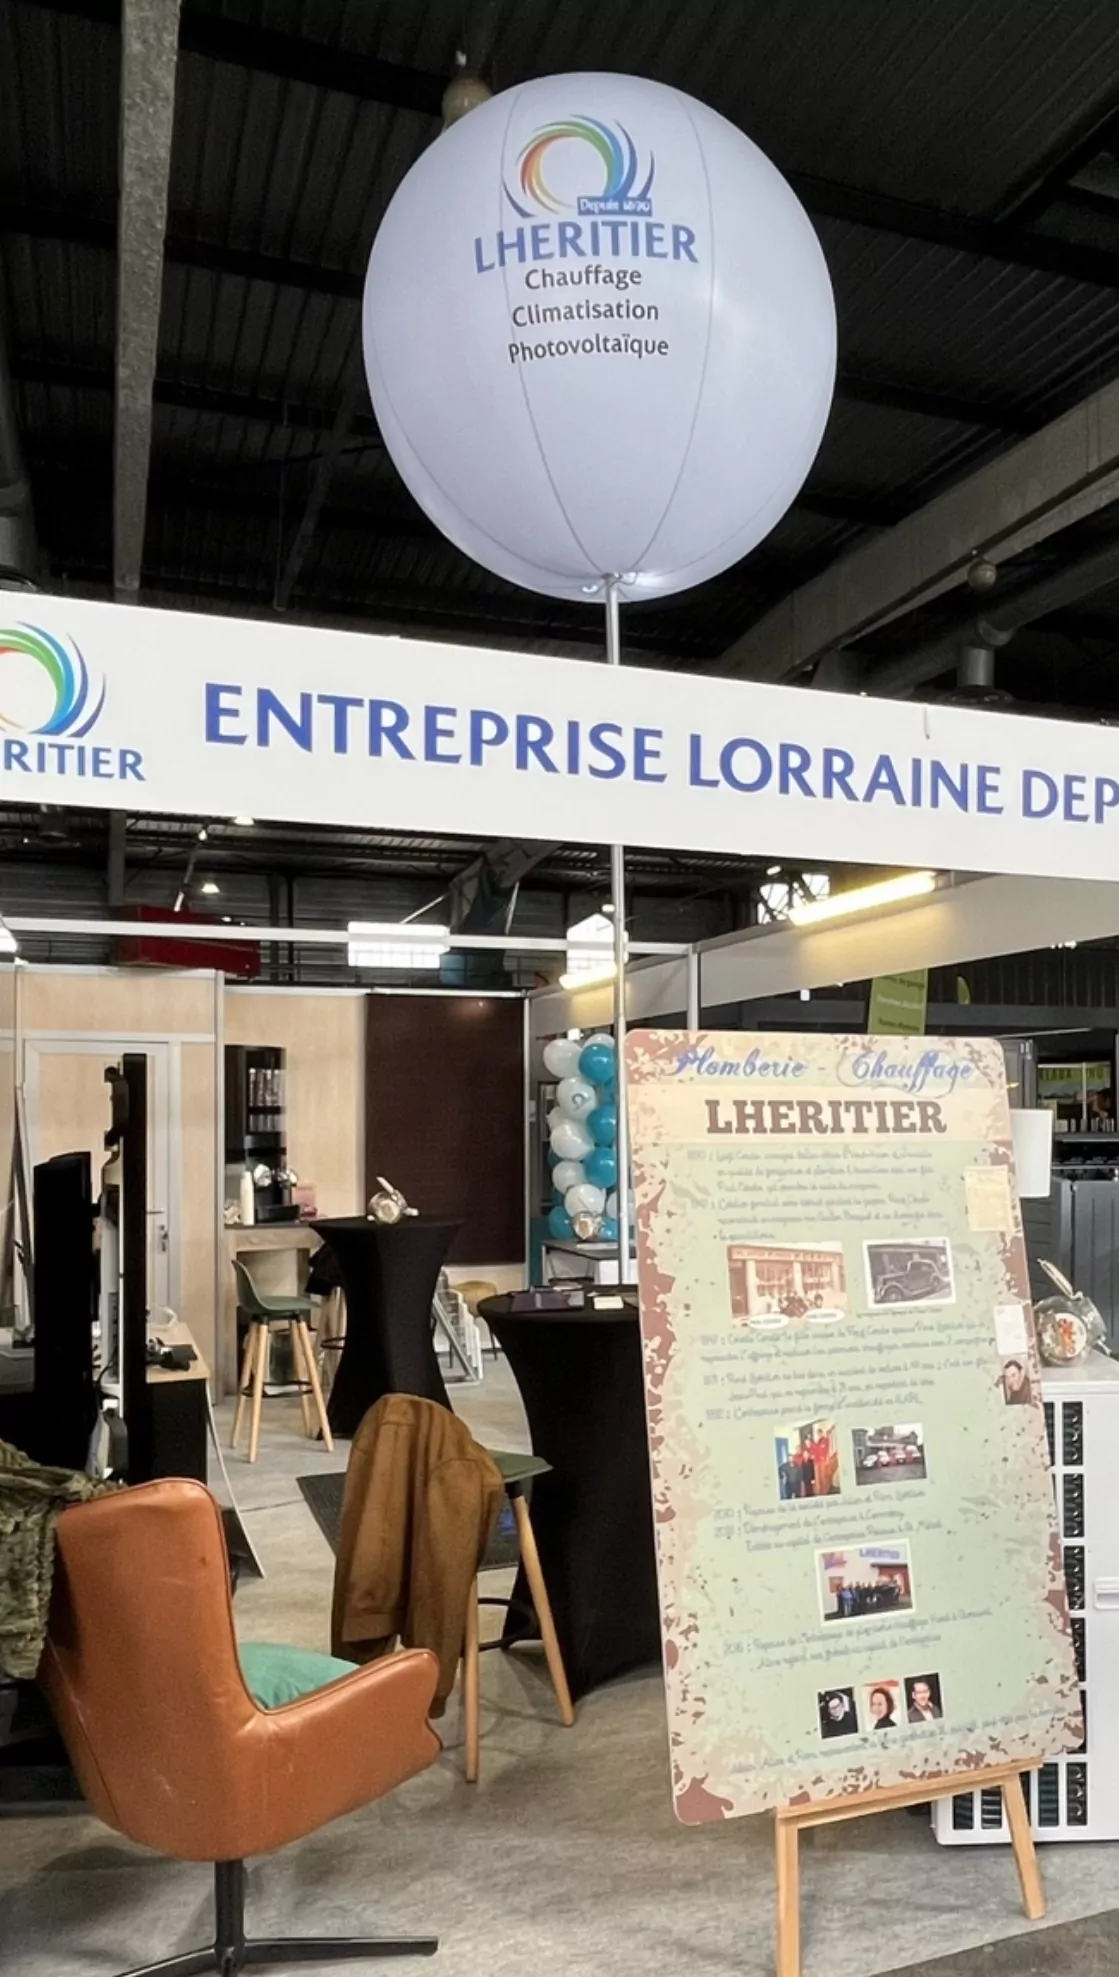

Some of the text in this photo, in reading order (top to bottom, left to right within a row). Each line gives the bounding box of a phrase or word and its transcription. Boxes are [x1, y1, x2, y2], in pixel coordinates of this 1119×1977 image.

[474, 220, 699, 275] LHERITIER
[524, 263, 642, 291] Chauffage
[511, 298, 659, 328] Climatisation
[507, 332, 669, 365] Photovoltaïque
[3, 738, 146, 782] RITIER
[205, 682, 1119, 824] ENTREPRISE LORRAINE DEP
[670, 1047, 808, 1078] Plomberie
[842, 1047, 974, 1096] Chauffage
[704, 1099, 948, 1135] LHERITIER
